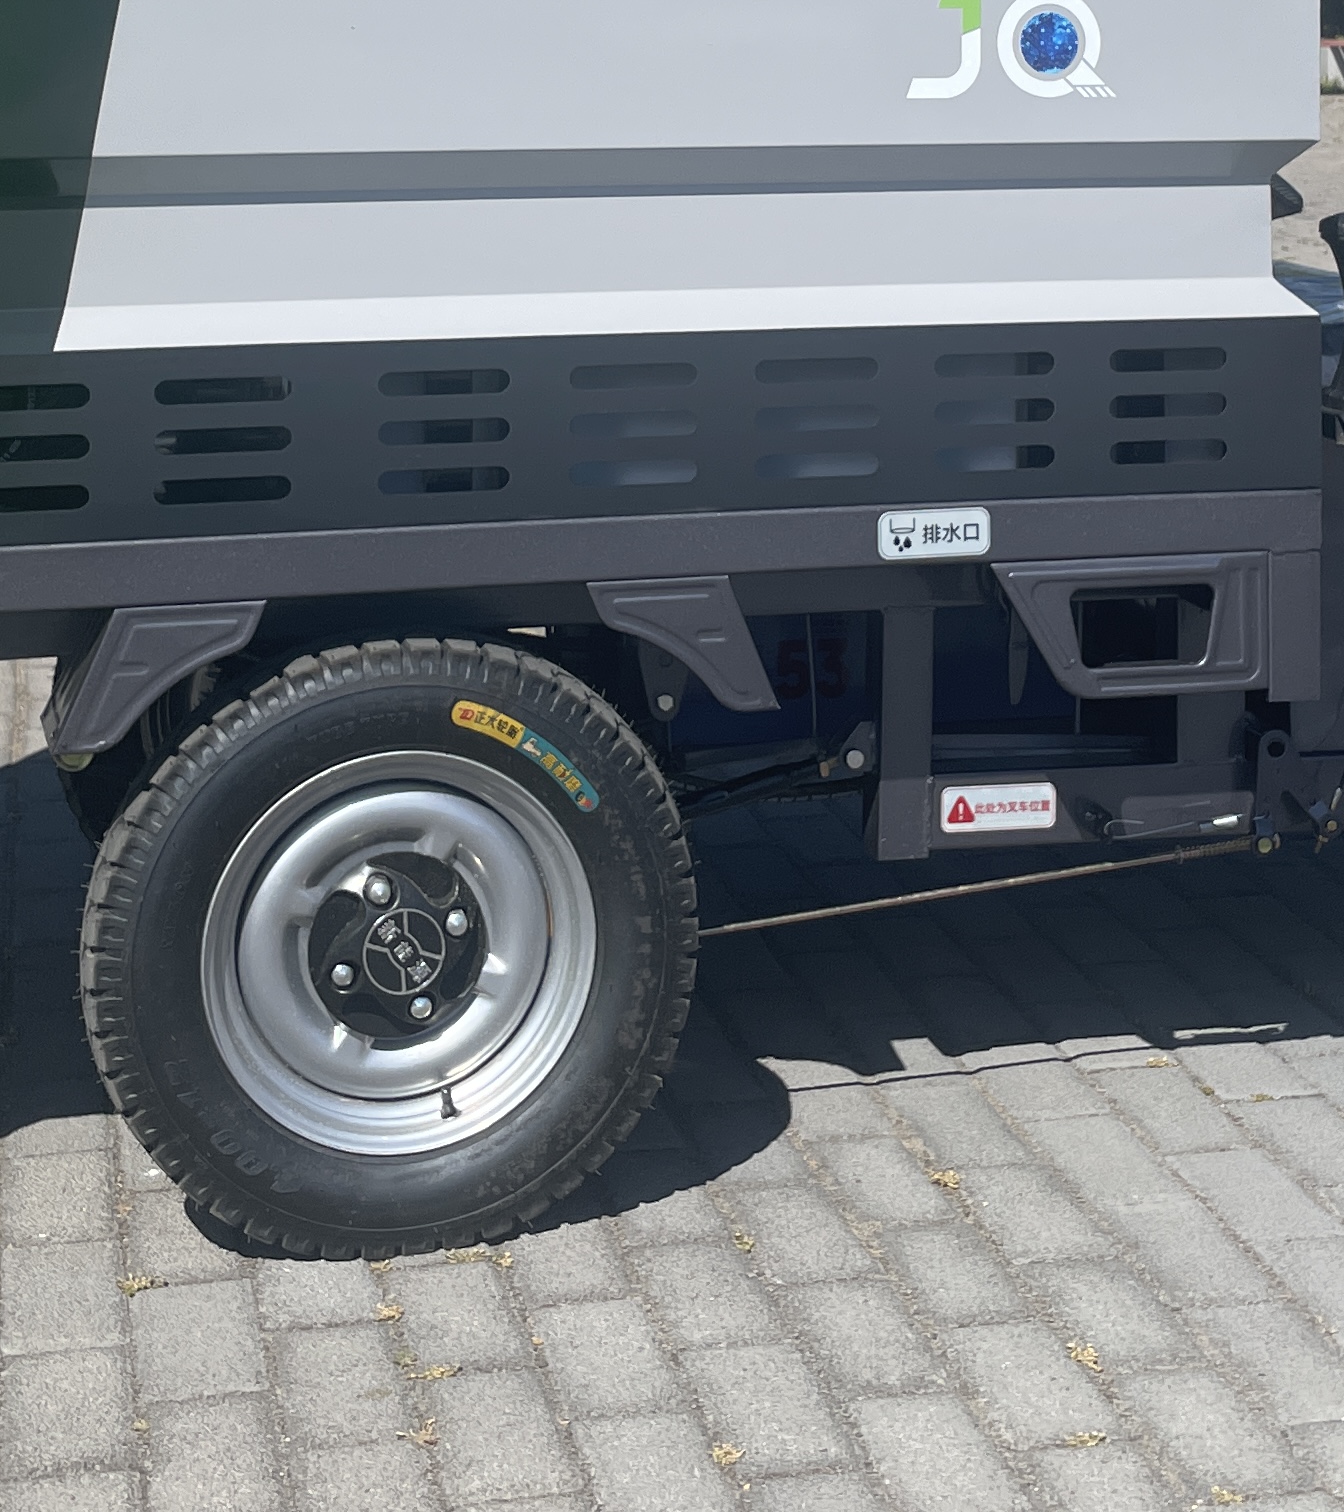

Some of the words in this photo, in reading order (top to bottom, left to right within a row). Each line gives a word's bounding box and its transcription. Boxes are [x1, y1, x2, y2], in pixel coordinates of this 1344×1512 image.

[922, 522, 980, 544] 排水口
[776, 637, 850, 699] 53
[377, 918, 433, 984] 新能源
